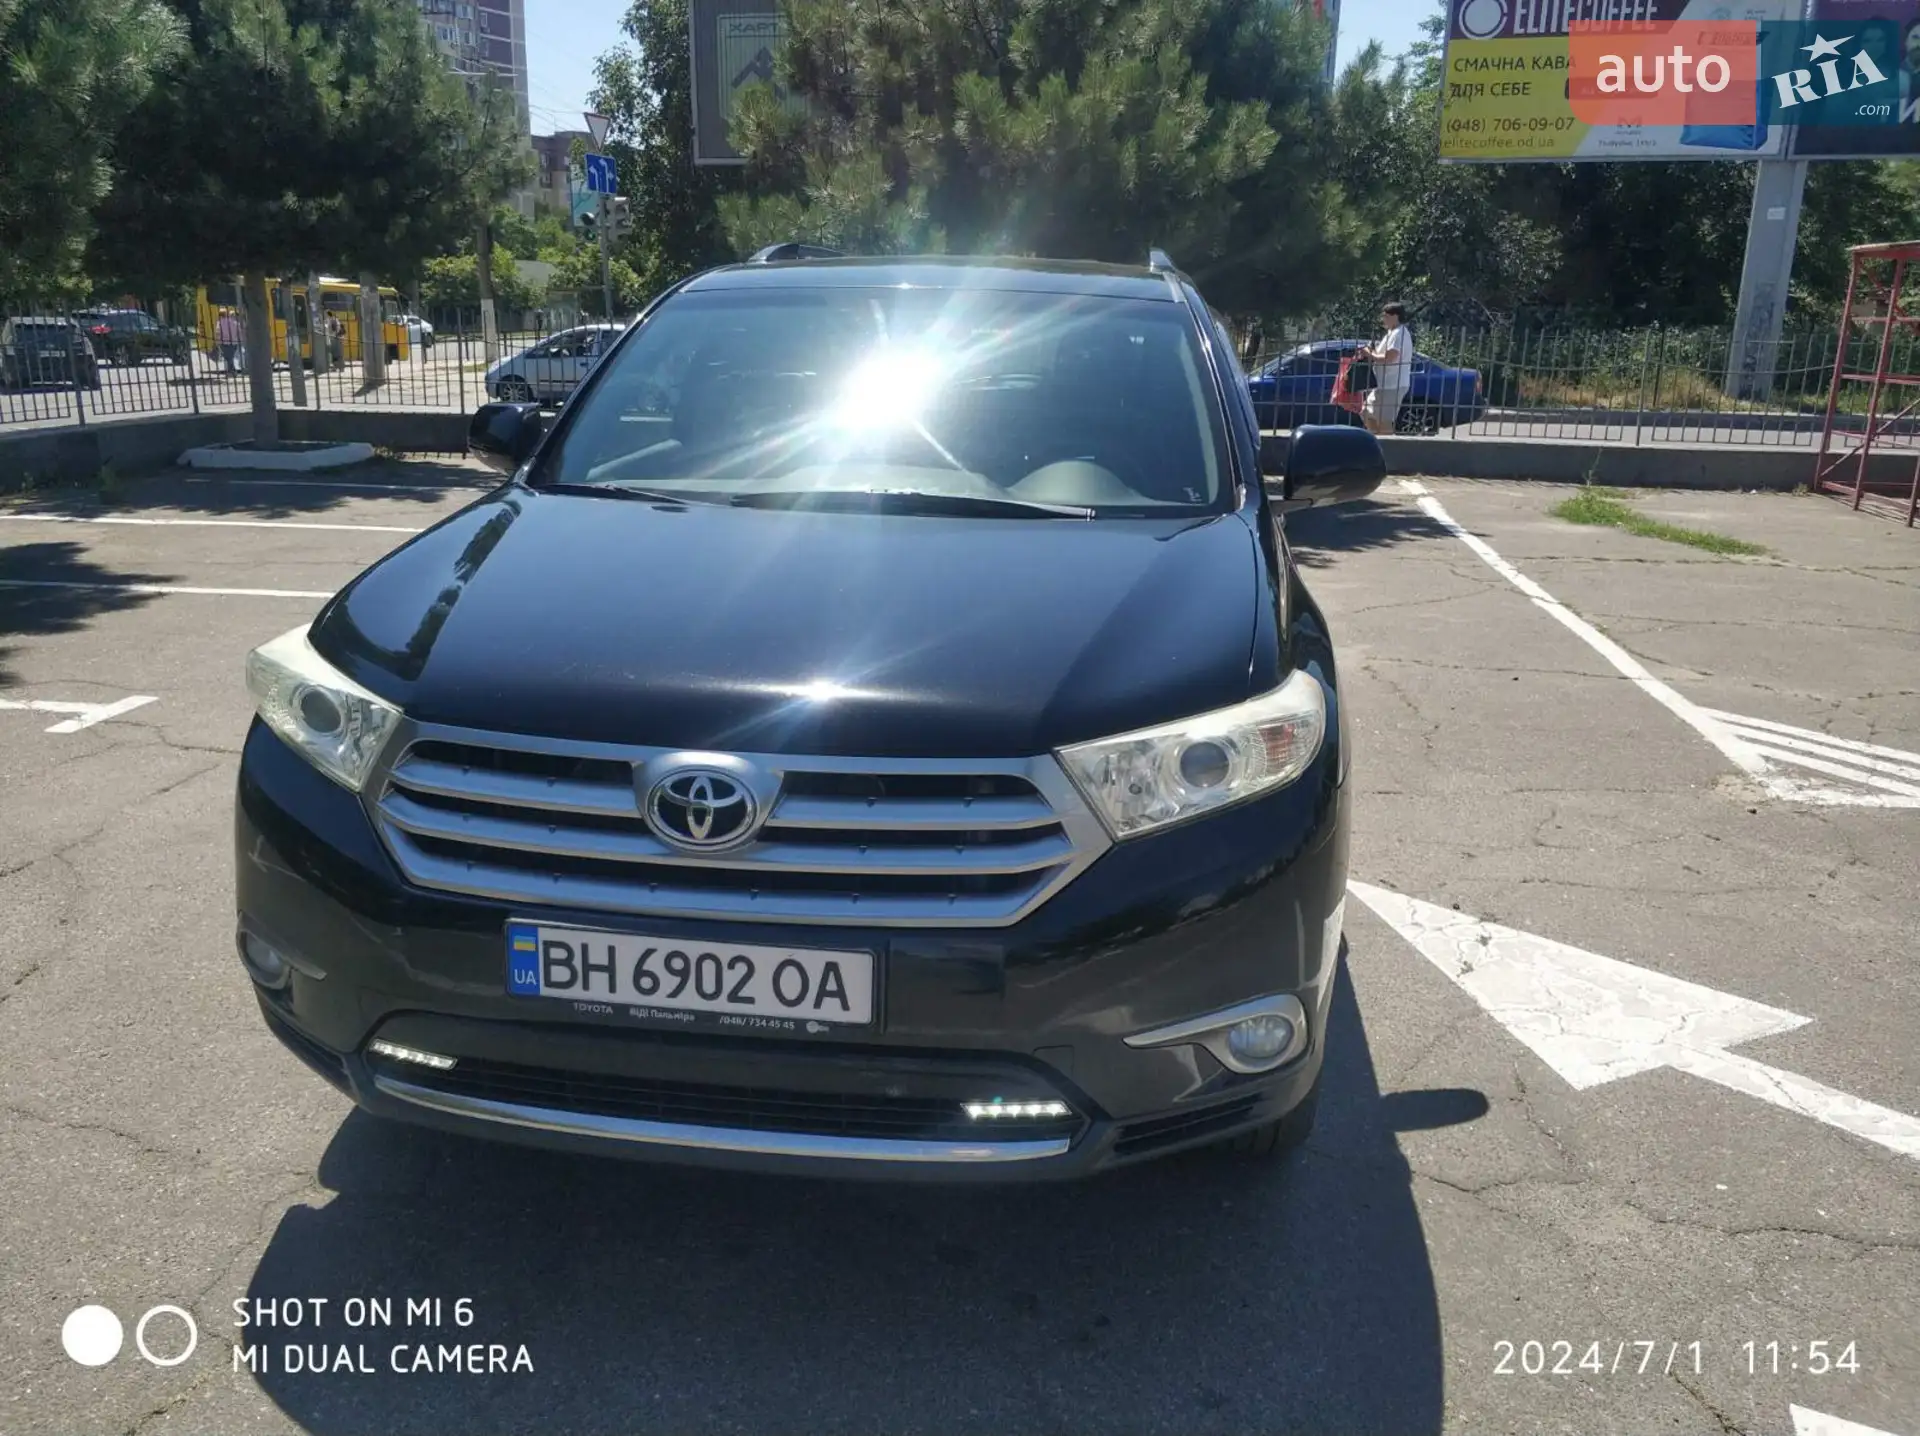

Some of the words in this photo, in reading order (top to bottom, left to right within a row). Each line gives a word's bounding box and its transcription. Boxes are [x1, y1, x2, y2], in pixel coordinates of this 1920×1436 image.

[1513, 0, 1658, 36] ELITECOFFEE
[1454, 56, 1526, 73] СМАЧНА
[1531, 54, 1576, 71] КАВА
[1490, 81, 1533, 97] СЕБЕ
[1446, 118, 1486, 133] (048)
[1493, 116, 1576, 132] 706-09-07
[513, 968, 538, 988] UA
[540, 938, 618, 995] BH
[631, 946, 757, 1006] 6902
[771, 957, 852, 1013] OA
[573, 1002, 614, 1015] TOYOTA
